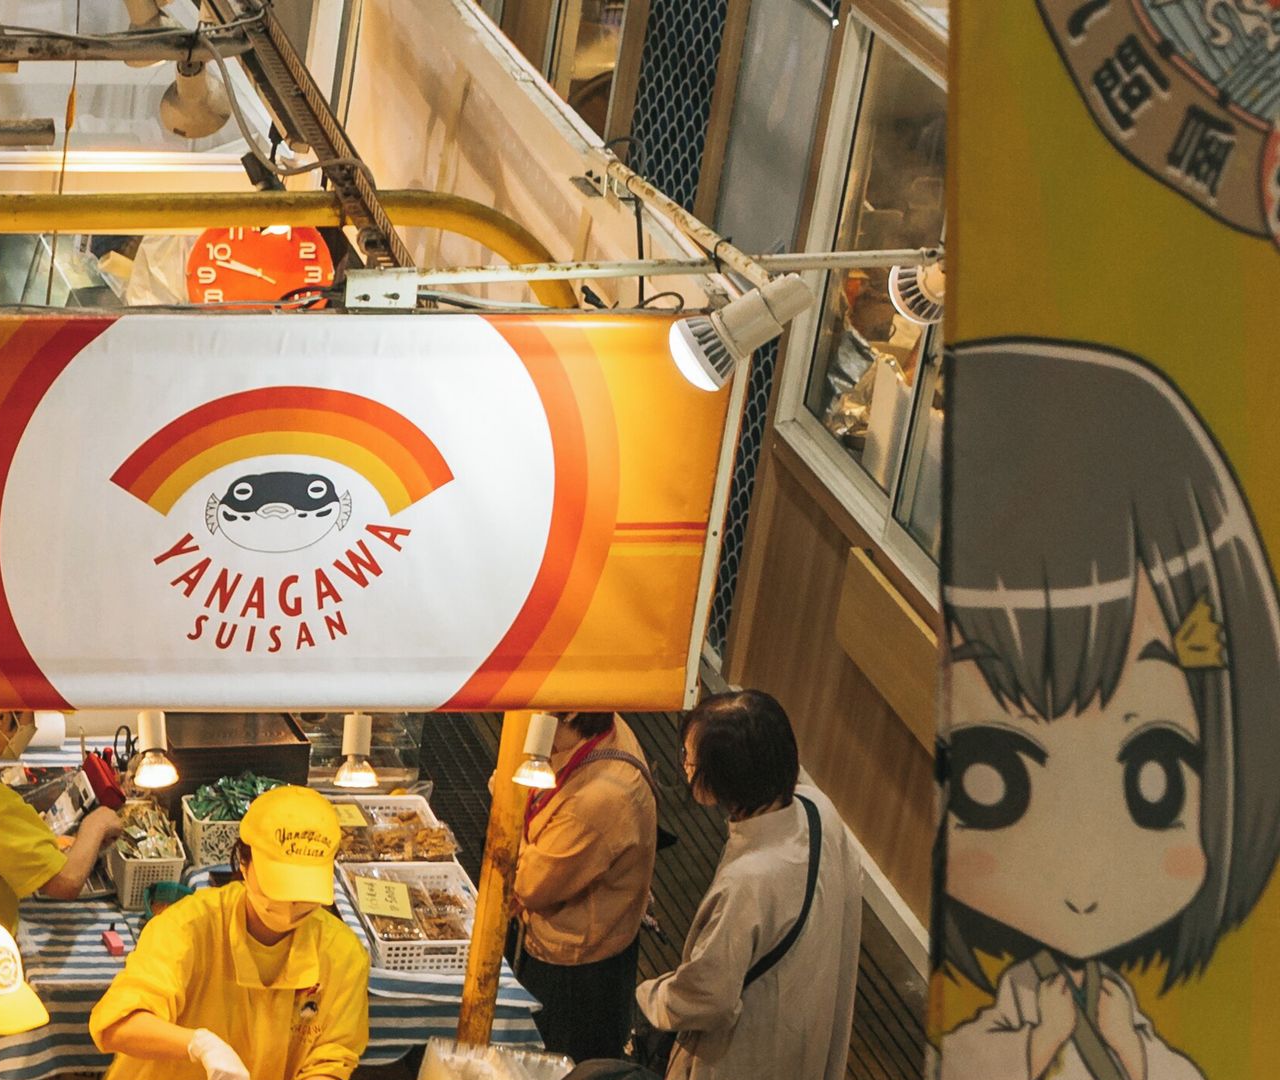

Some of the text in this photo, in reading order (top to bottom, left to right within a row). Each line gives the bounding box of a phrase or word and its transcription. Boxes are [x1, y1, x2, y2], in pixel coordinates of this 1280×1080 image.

[206, 243, 232, 261] 10
[299, 241, 317, 259] 2
[197, 266, 217, 284] 9
[303, 265, 323, 284] 3
[153, 519, 411, 620] YANAGAWA
[186, 610, 349, 653] SUISAN
